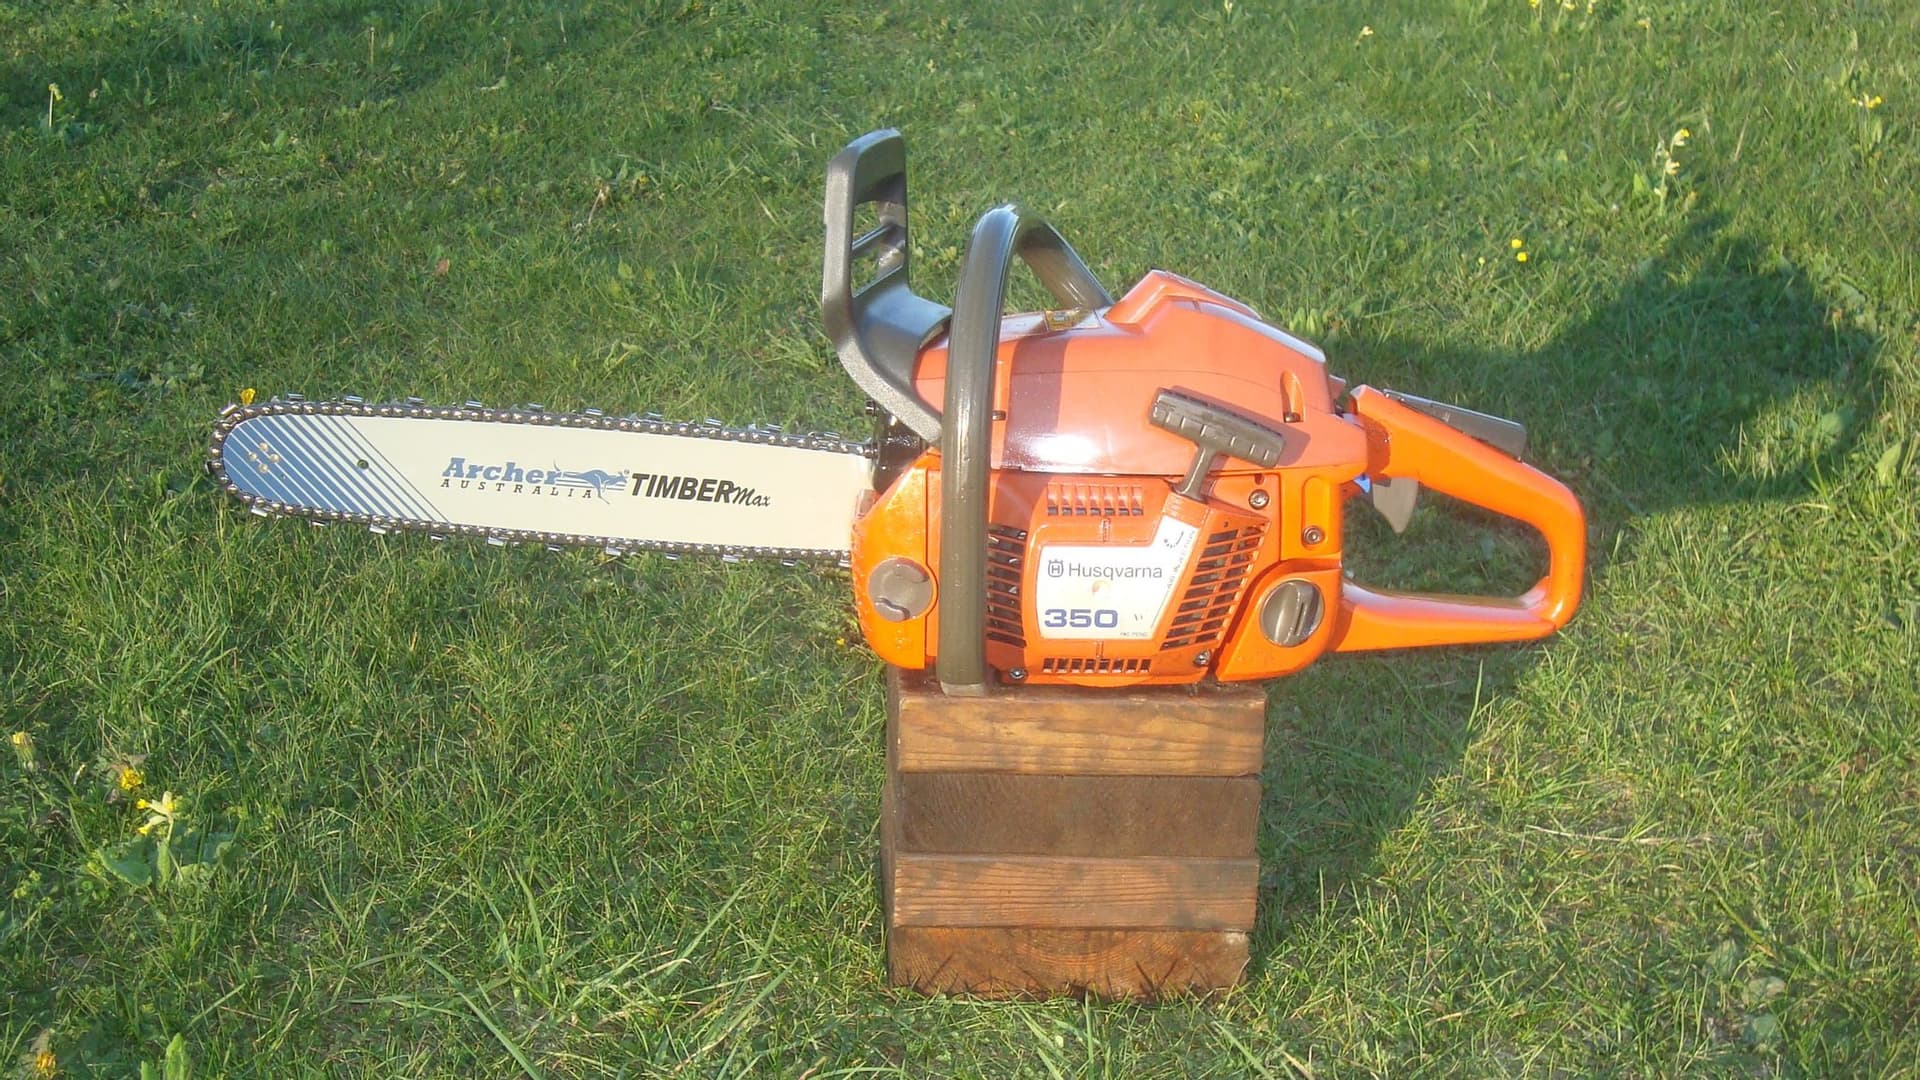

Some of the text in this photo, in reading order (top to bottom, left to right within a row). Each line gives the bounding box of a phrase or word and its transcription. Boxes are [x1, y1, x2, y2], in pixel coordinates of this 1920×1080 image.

[443, 457, 562, 486] Archer
[441, 479, 593, 499] AUSTRALIA
[1068, 562, 1163, 581] Husqvarna
[1044, 608, 1119, 629] 350
